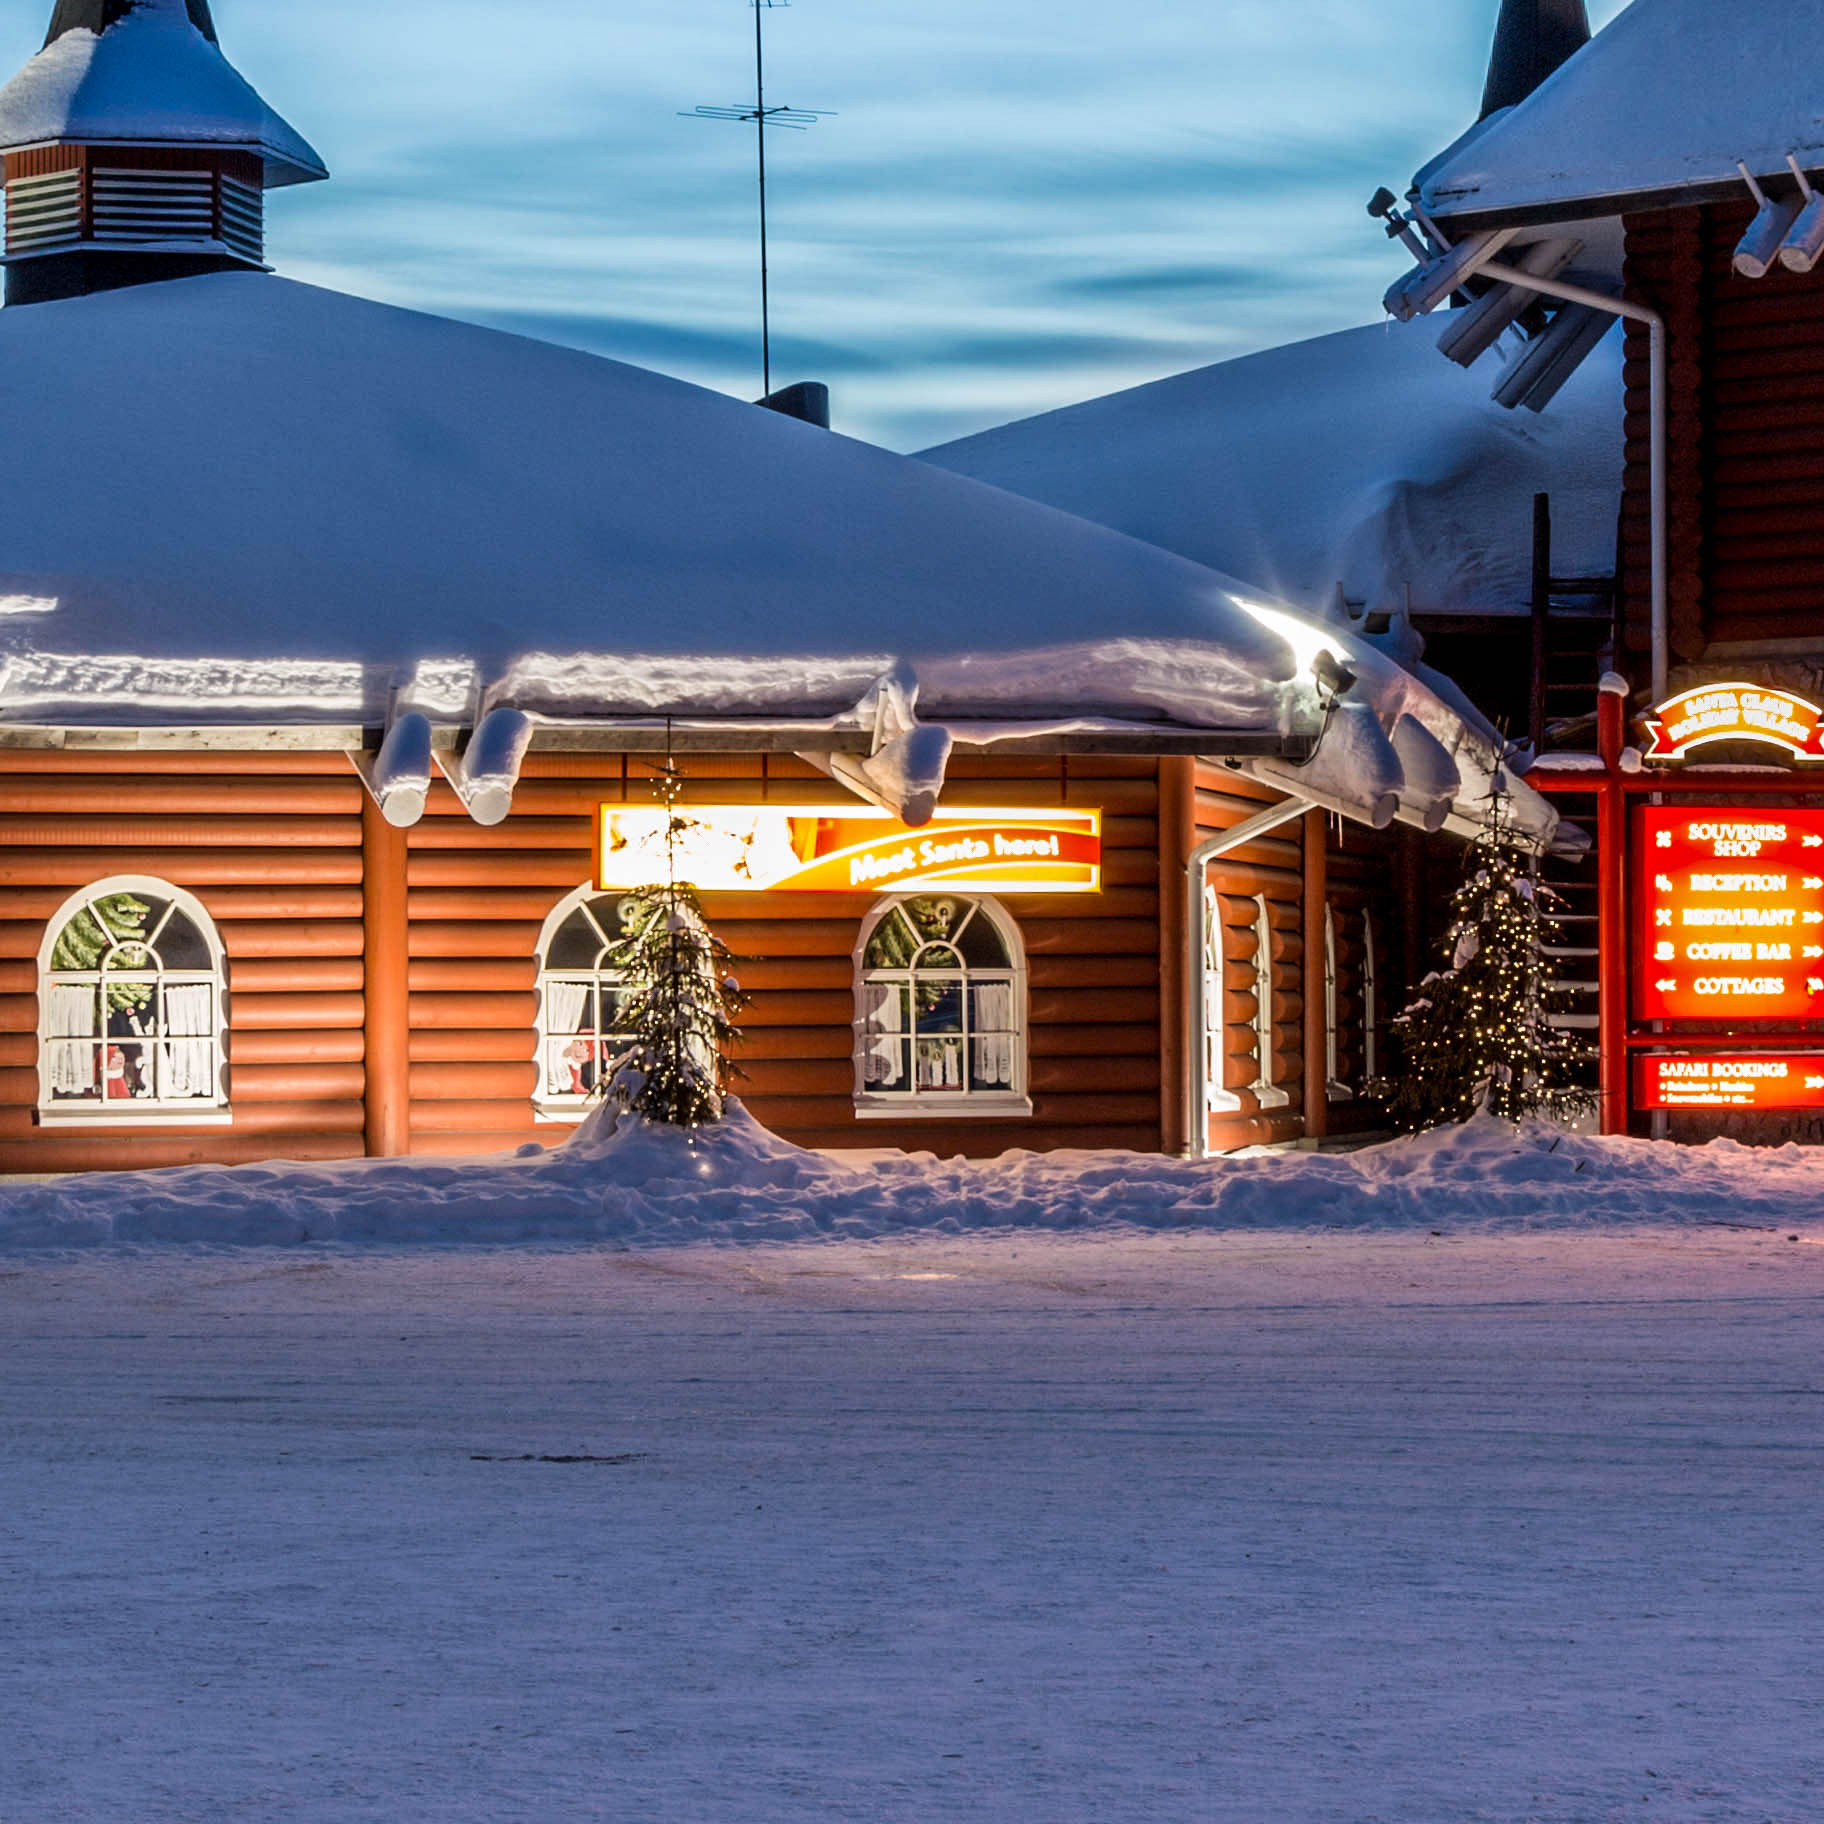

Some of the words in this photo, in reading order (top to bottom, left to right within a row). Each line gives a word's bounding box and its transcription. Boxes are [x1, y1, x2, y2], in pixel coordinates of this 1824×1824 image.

[1688, 824, 1787, 841] SOUVENIRS
[1714, 840, 1761, 856] SHOP
[850, 846, 916, 886] Meet
[920, 837, 989, 866] Santa
[994, 833, 1059, 856] here!
[1690, 874, 1787, 891] RECEPTION
[1682, 908, 1796, 926] RESTAURANT
[1686, 943, 1752, 960] COFFEE
[1756, 943, 1791, 960] BAR
[1694, 977, 1785, 994] COTTAGES
[1659, 1063, 1708, 1077] SAFARI
[1712, 1063, 1788, 1077] BOOKINGS
